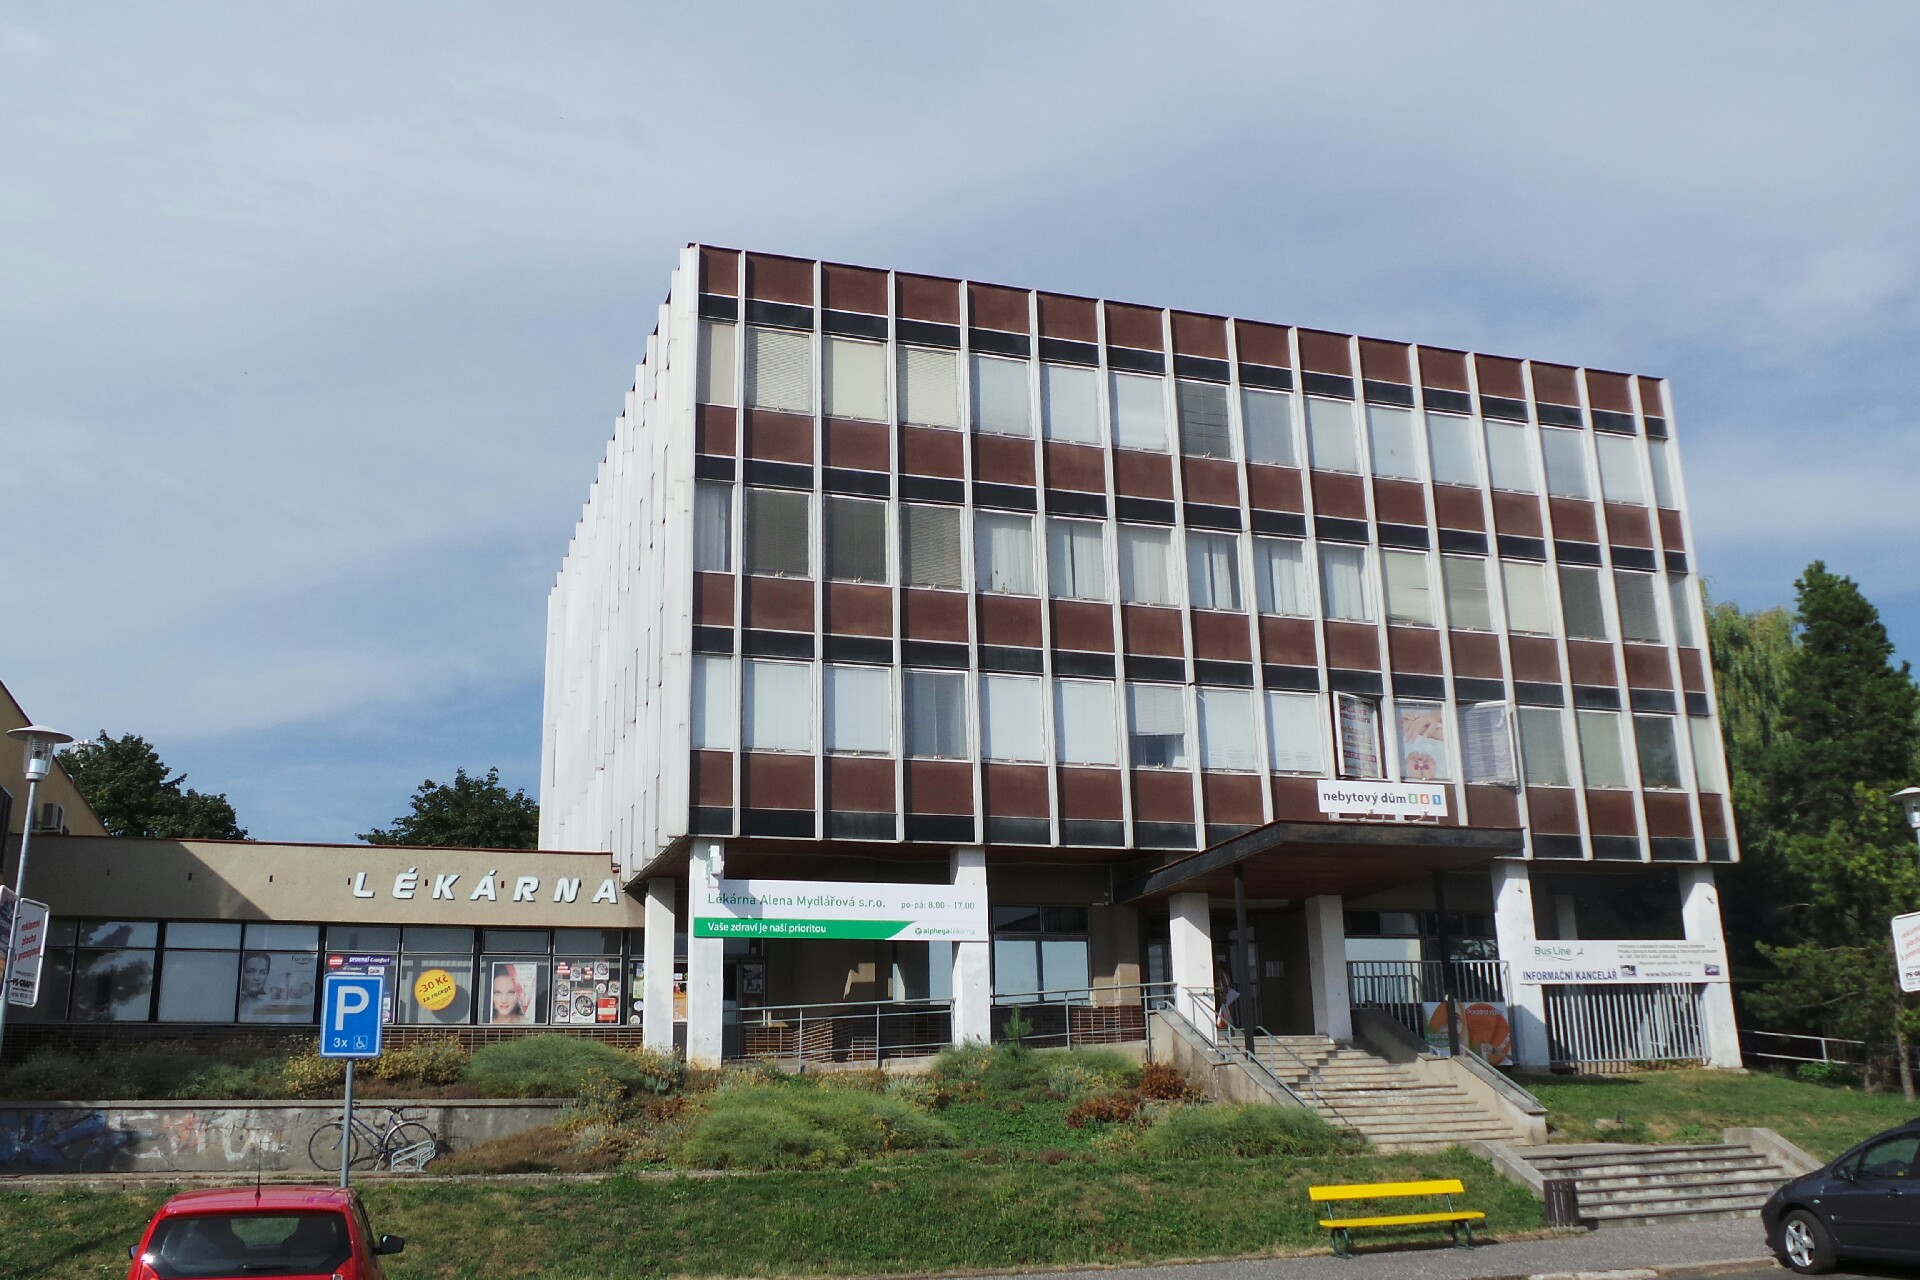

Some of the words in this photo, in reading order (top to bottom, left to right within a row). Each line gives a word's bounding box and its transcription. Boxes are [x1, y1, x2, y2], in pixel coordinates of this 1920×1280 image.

[1323, 791, 1378, 805] nebytový
[1381, 792, 1407, 803] dům
[353, 867, 620, 904] LÉKÁRNA
[708, 893, 756, 905] Lékárna
[760, 894, 793, 906] Alena
[797, 895, 855, 909] Mydlářová
[858, 899, 886, 908] s.r.o.
[901, 901, 926, 910] po-pá:
[928, 901, 945, 909] 8.00
[954, 901, 975, 910] 17.00
[708, 922, 729, 931] Vaše
[730, 922, 758, 932] zdraví
[759, 923, 768, 934] je
[768, 923, 787, 933] naší
[788, 924, 826, 934] prioritou
[1522, 969, 1573, 981] INFORMAČNÍ
[1575, 968, 1618, 980] KANCELÁŘ
[419, 981, 434, 993] -30
[435, 975, 448, 986] Kč
[431, 985, 451, 999] recept
[335, 986, 369, 1031] P
[333, 1037, 348, 1048] 3x
